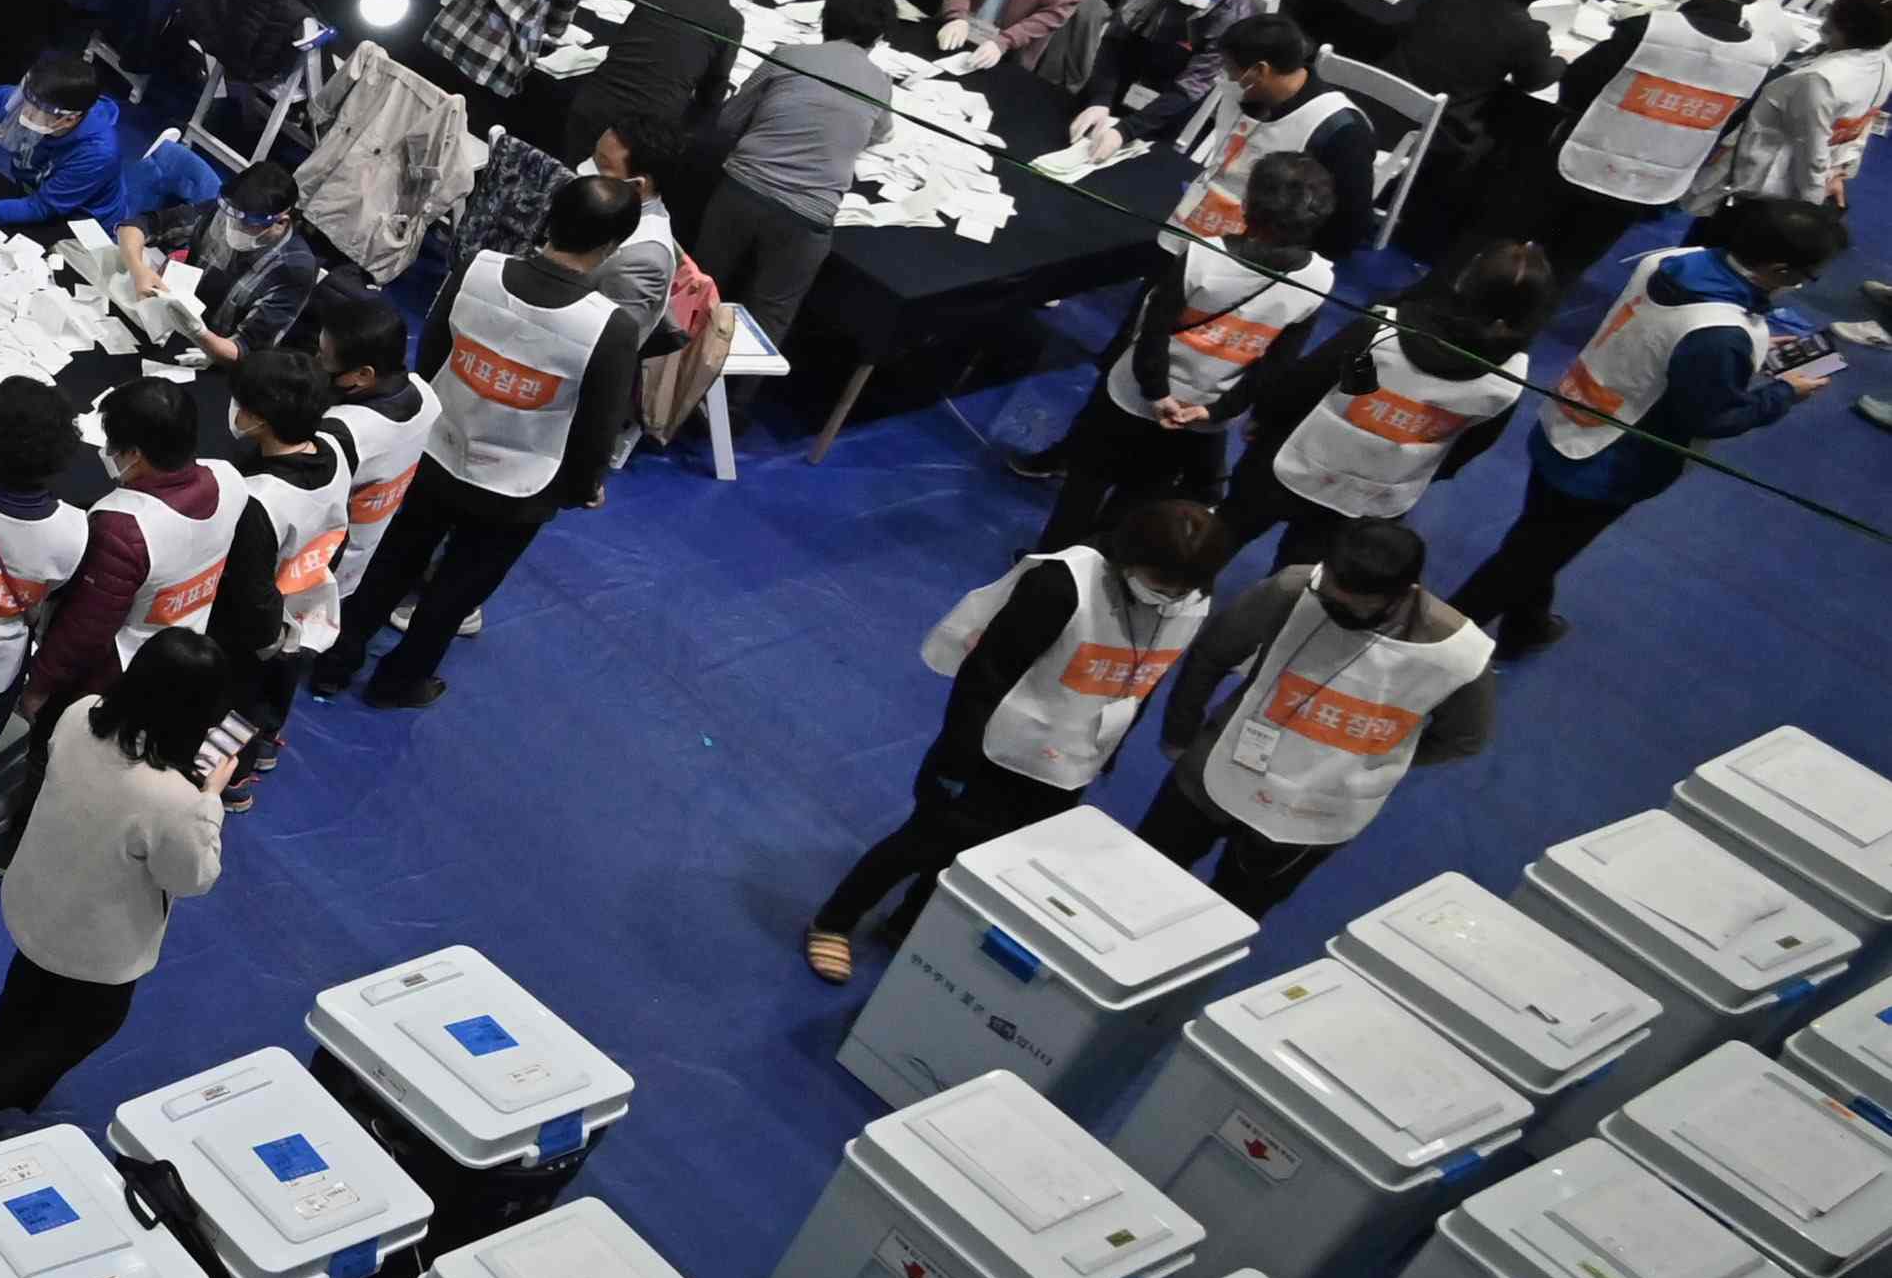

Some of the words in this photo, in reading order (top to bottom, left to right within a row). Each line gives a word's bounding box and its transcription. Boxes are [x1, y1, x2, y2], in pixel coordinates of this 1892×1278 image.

[1640, 85, 1724, 121] 개표참관
[457, 349, 544, 402] 개표참관
[1282, 689, 1400, 747] 개표참관
